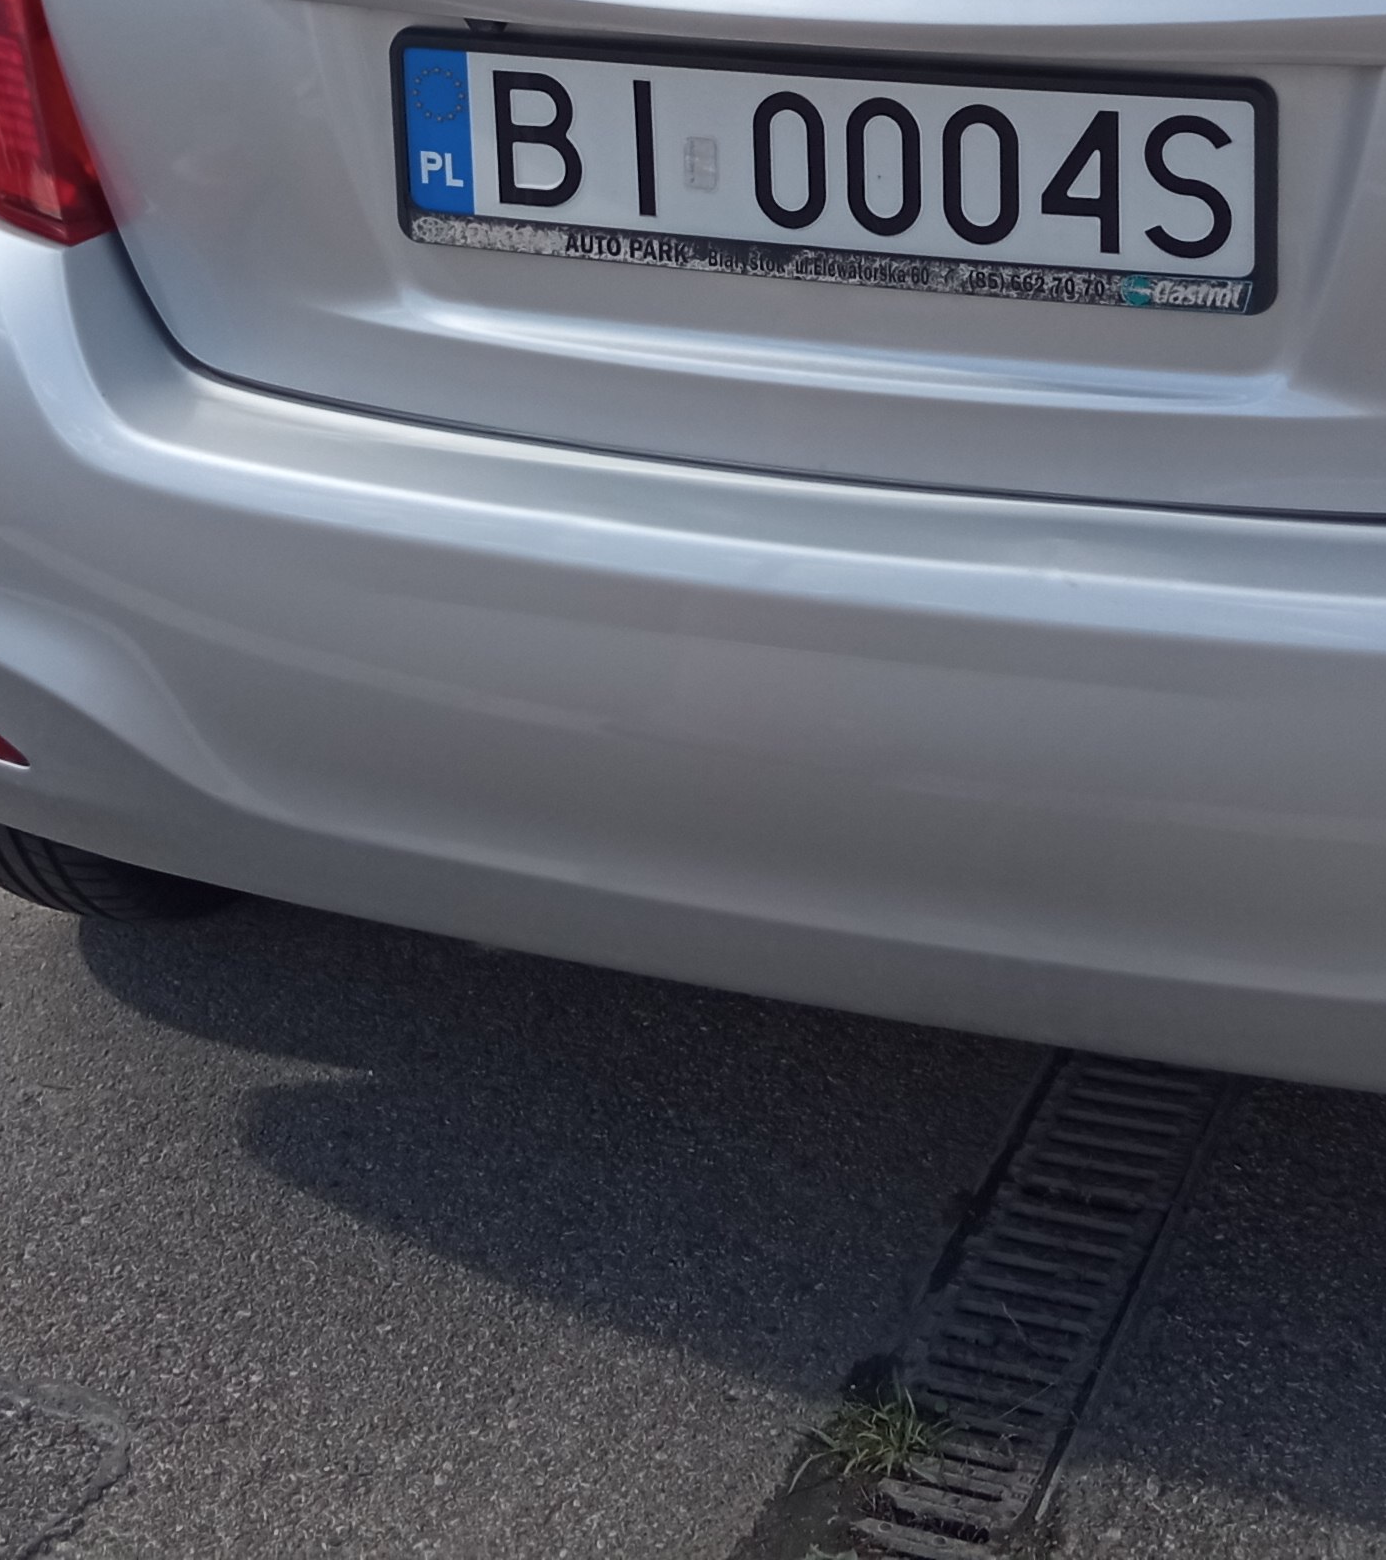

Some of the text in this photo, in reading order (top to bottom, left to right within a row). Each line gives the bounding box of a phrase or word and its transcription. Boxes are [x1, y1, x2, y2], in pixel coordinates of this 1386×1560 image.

[420, 150, 464, 188] PL
[493, 70, 1232, 259] BI 0004S
[565, 234, 621, 257] AUTO
[629, 239, 689, 264] PARK
